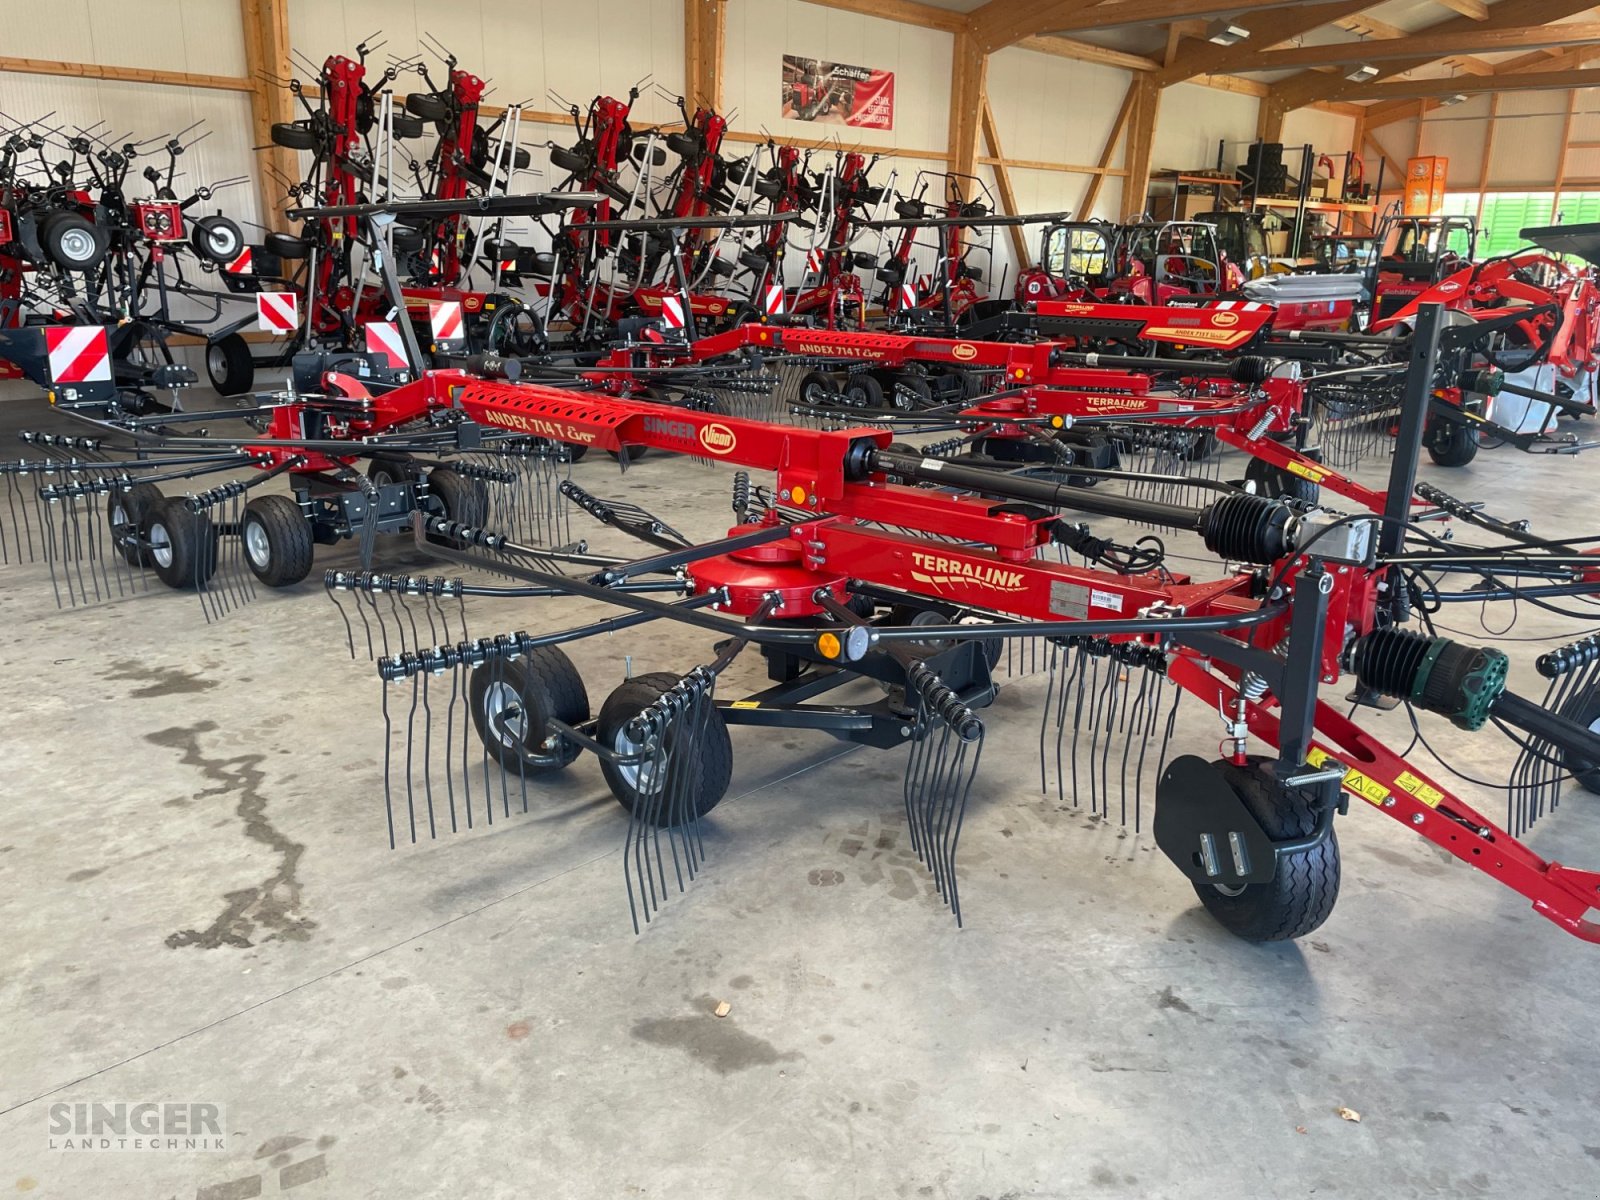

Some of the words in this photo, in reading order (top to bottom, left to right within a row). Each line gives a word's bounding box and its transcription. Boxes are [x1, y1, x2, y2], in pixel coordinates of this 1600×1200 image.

[832, 66, 870, 81] Schäffer
[1031, 284, 1039, 292] 20
[799, 344, 834, 355] ANDEX
[836, 345, 854, 356] 714
[854, 347, 861, 357] T
[862, 348, 884, 358] Evo
[1086, 397, 1147, 408] TERRALINK
[485, 409, 531, 431] ANDEX
[531, 418, 555, 436] 714
[554, 423, 565, 438] T
[567, 425, 596, 443] Evo
[643, 416, 696, 440] SINGER
[911, 552, 1025, 587] TERRALINK
